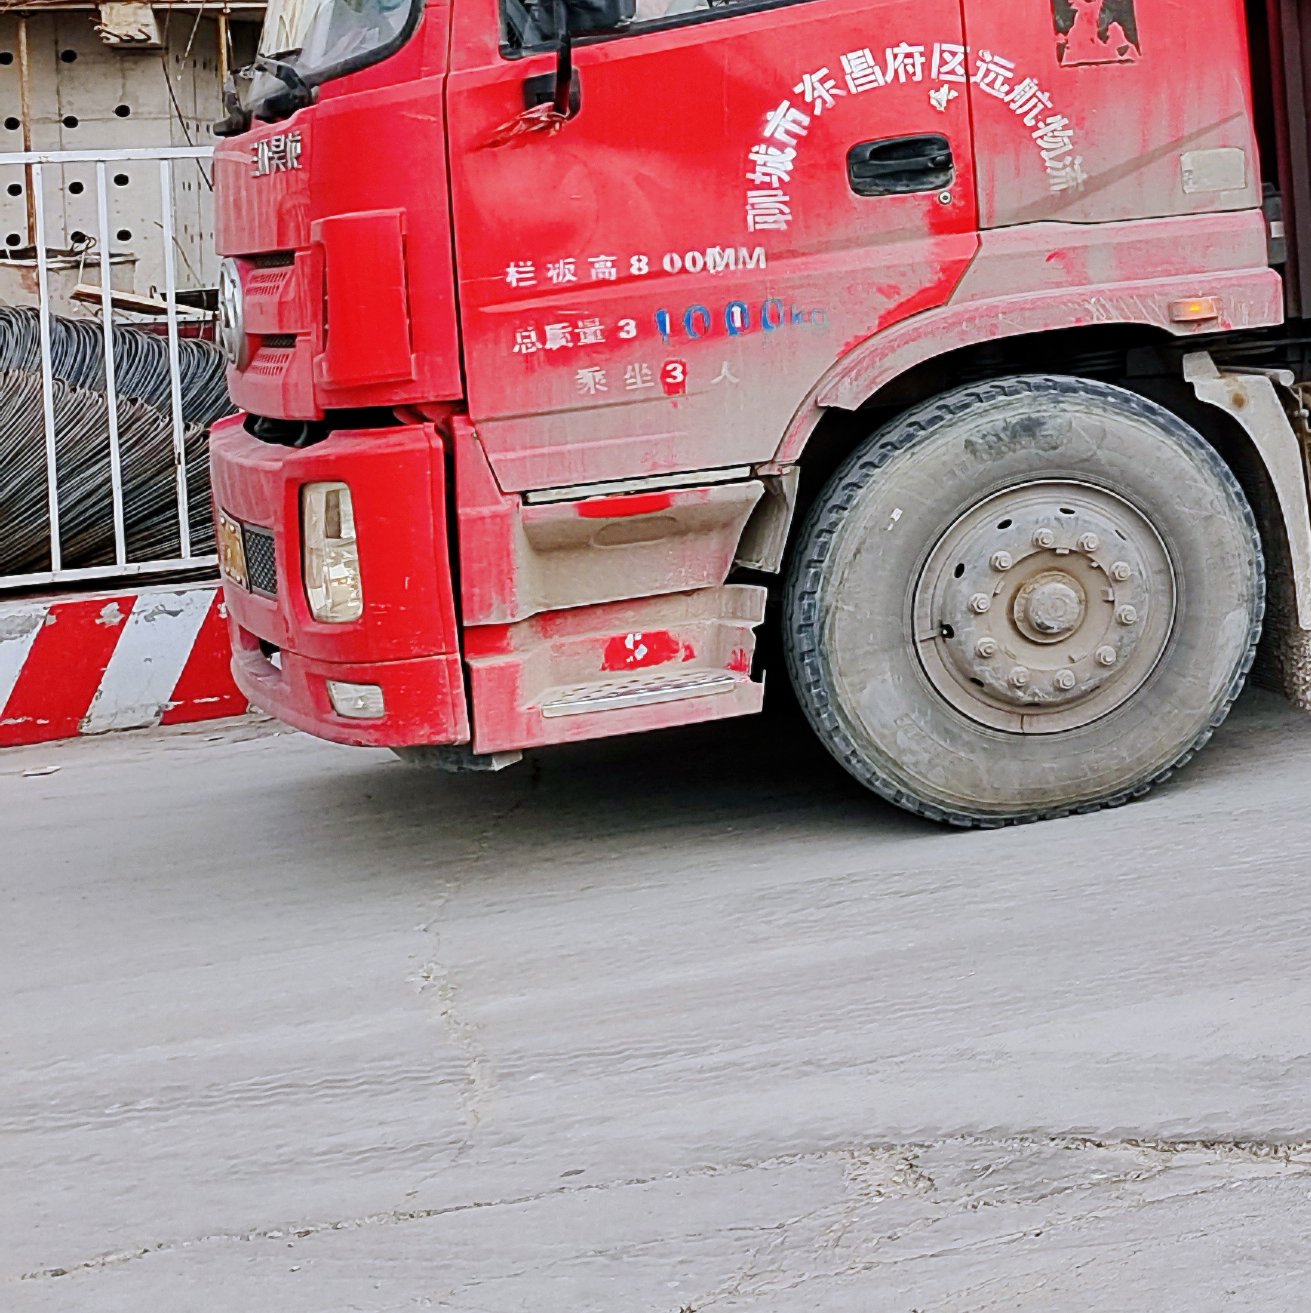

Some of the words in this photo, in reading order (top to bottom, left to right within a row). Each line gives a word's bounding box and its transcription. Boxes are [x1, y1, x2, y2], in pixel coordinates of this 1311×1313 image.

[745, 40, 1089, 233] 聊城市东昌府区远航物流
